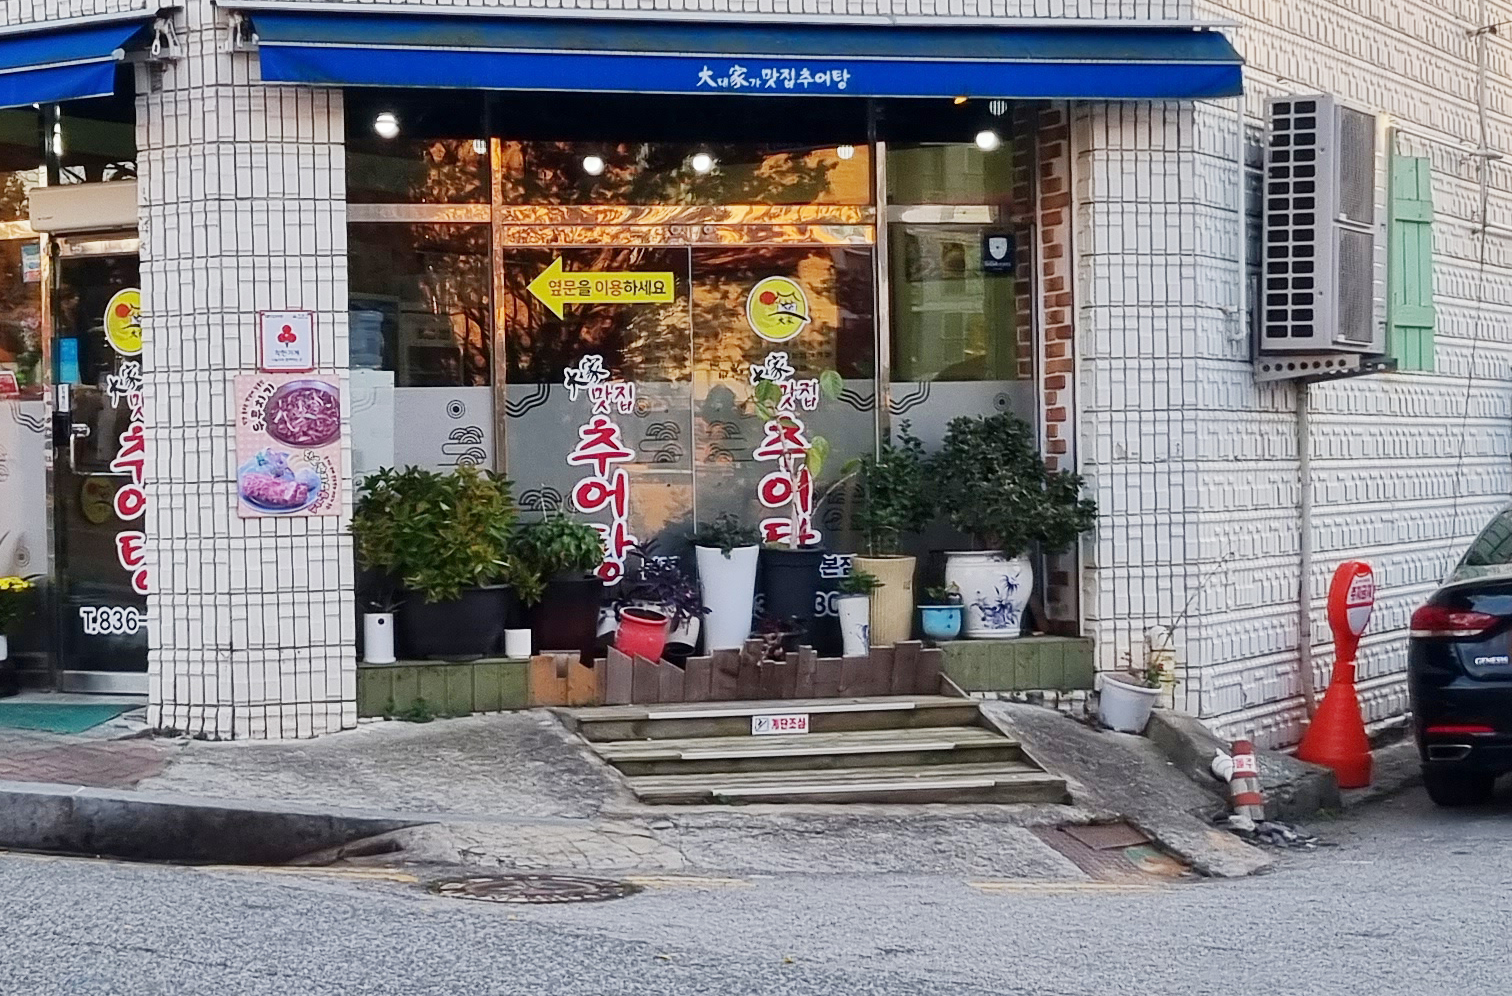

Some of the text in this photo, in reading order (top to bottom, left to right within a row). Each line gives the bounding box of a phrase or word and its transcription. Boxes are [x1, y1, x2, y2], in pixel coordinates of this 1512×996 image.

[548, 278, 667, 297] 옆문을 이용하세요
[590, 384, 634, 413] 맛집
